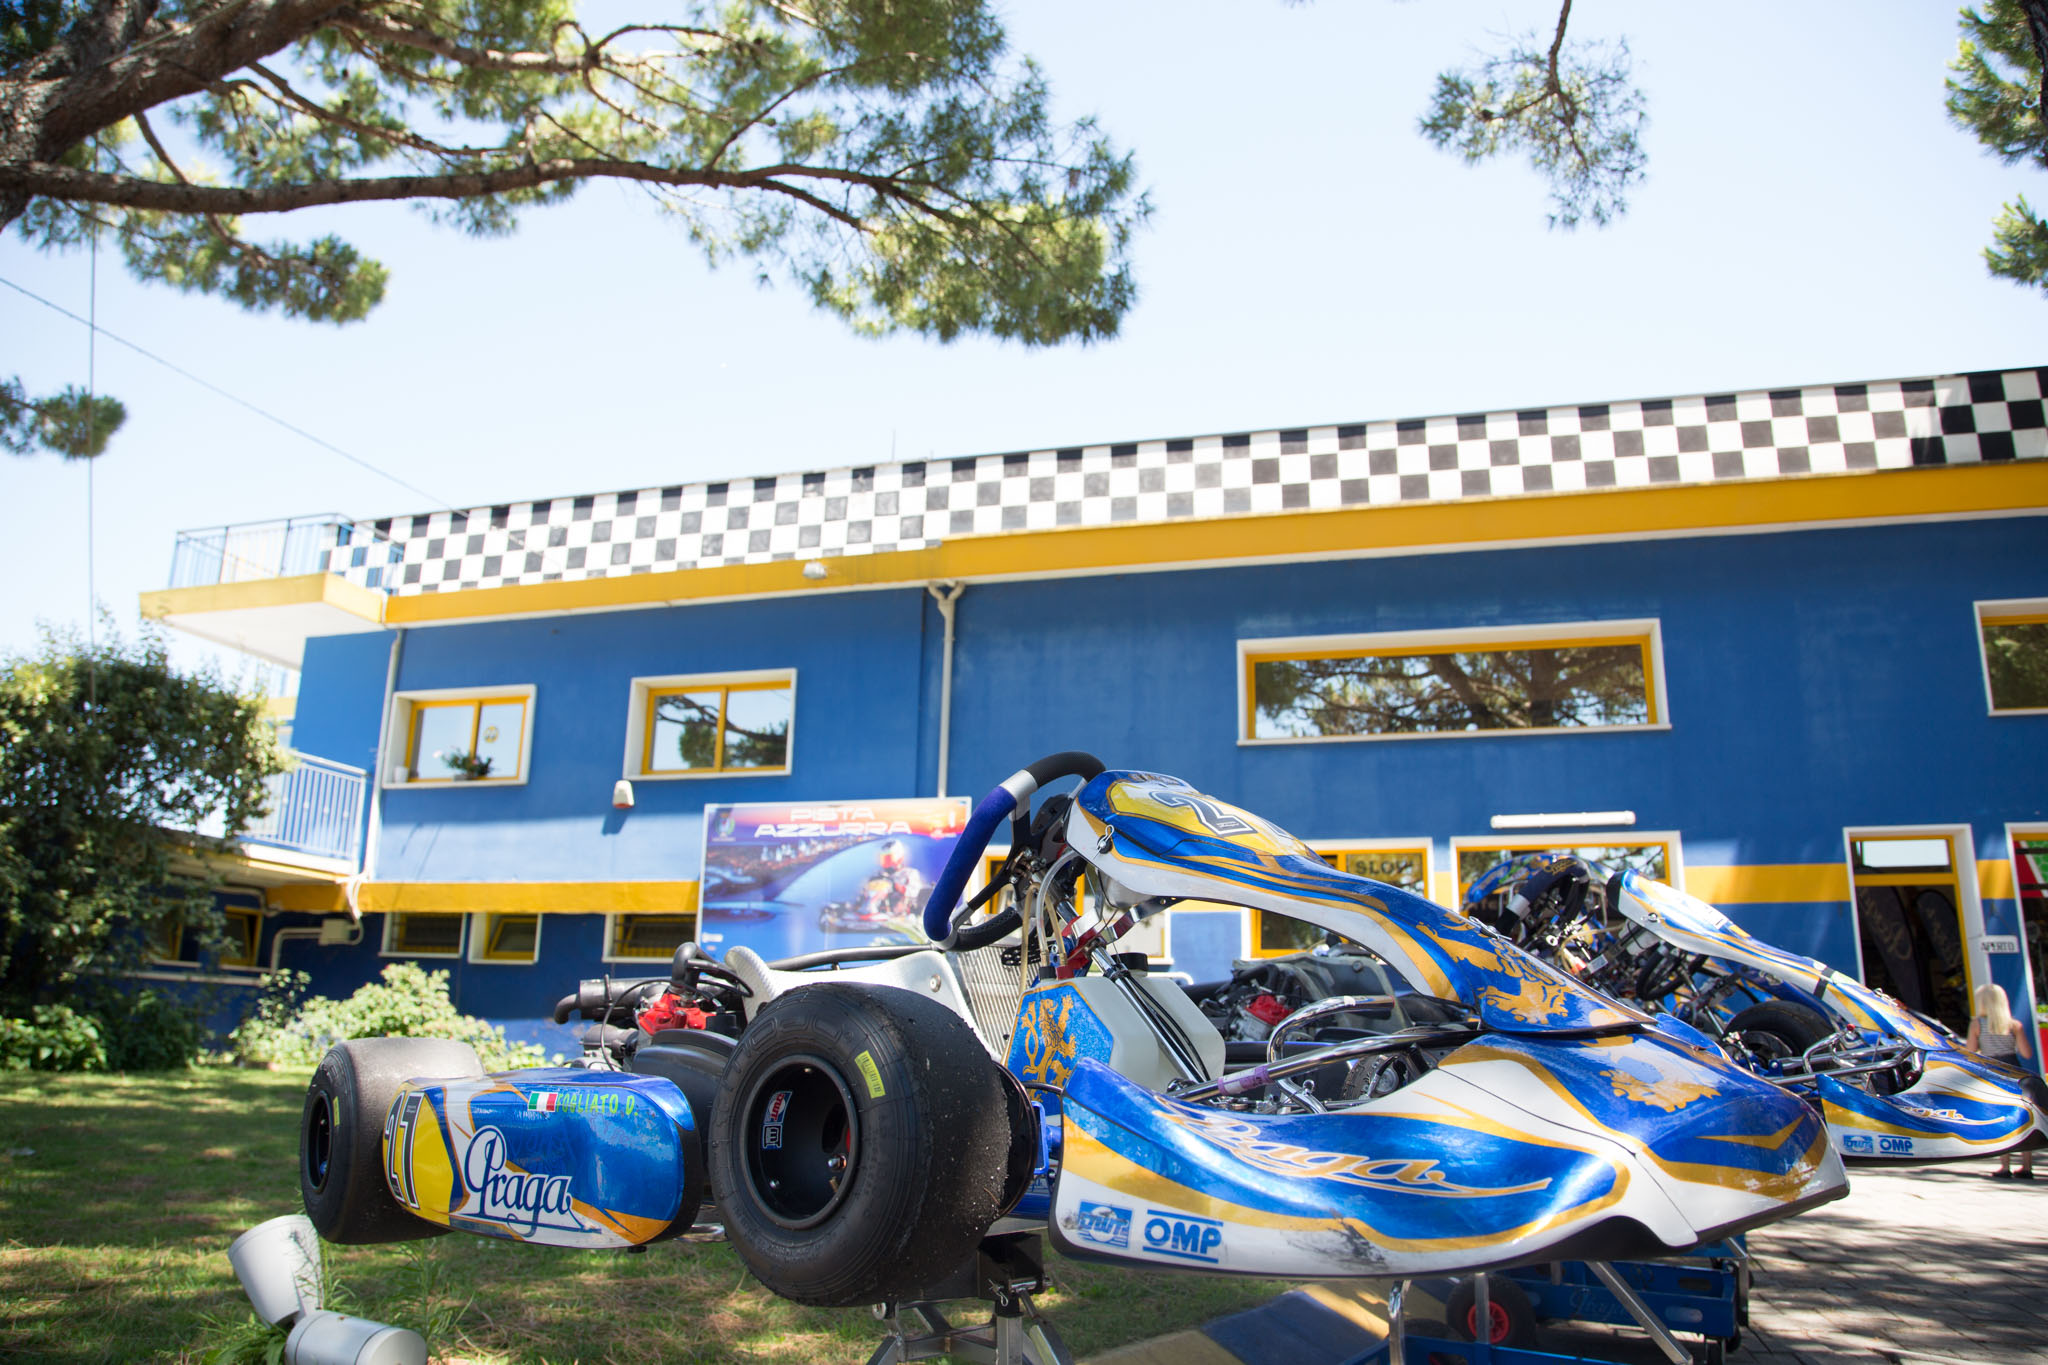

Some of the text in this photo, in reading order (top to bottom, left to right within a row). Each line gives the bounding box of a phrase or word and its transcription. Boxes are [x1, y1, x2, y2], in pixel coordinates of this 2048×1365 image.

[790, 807, 875, 822] PISTA
[753, 821, 913, 839] AZZURRA
[556, 1093, 620, 1114] FOGLIATO
[1880, 1139, 1914, 1153] OMP
[460, 1127, 602, 1237] Praga
[1144, 1217, 1223, 1255] OMP
